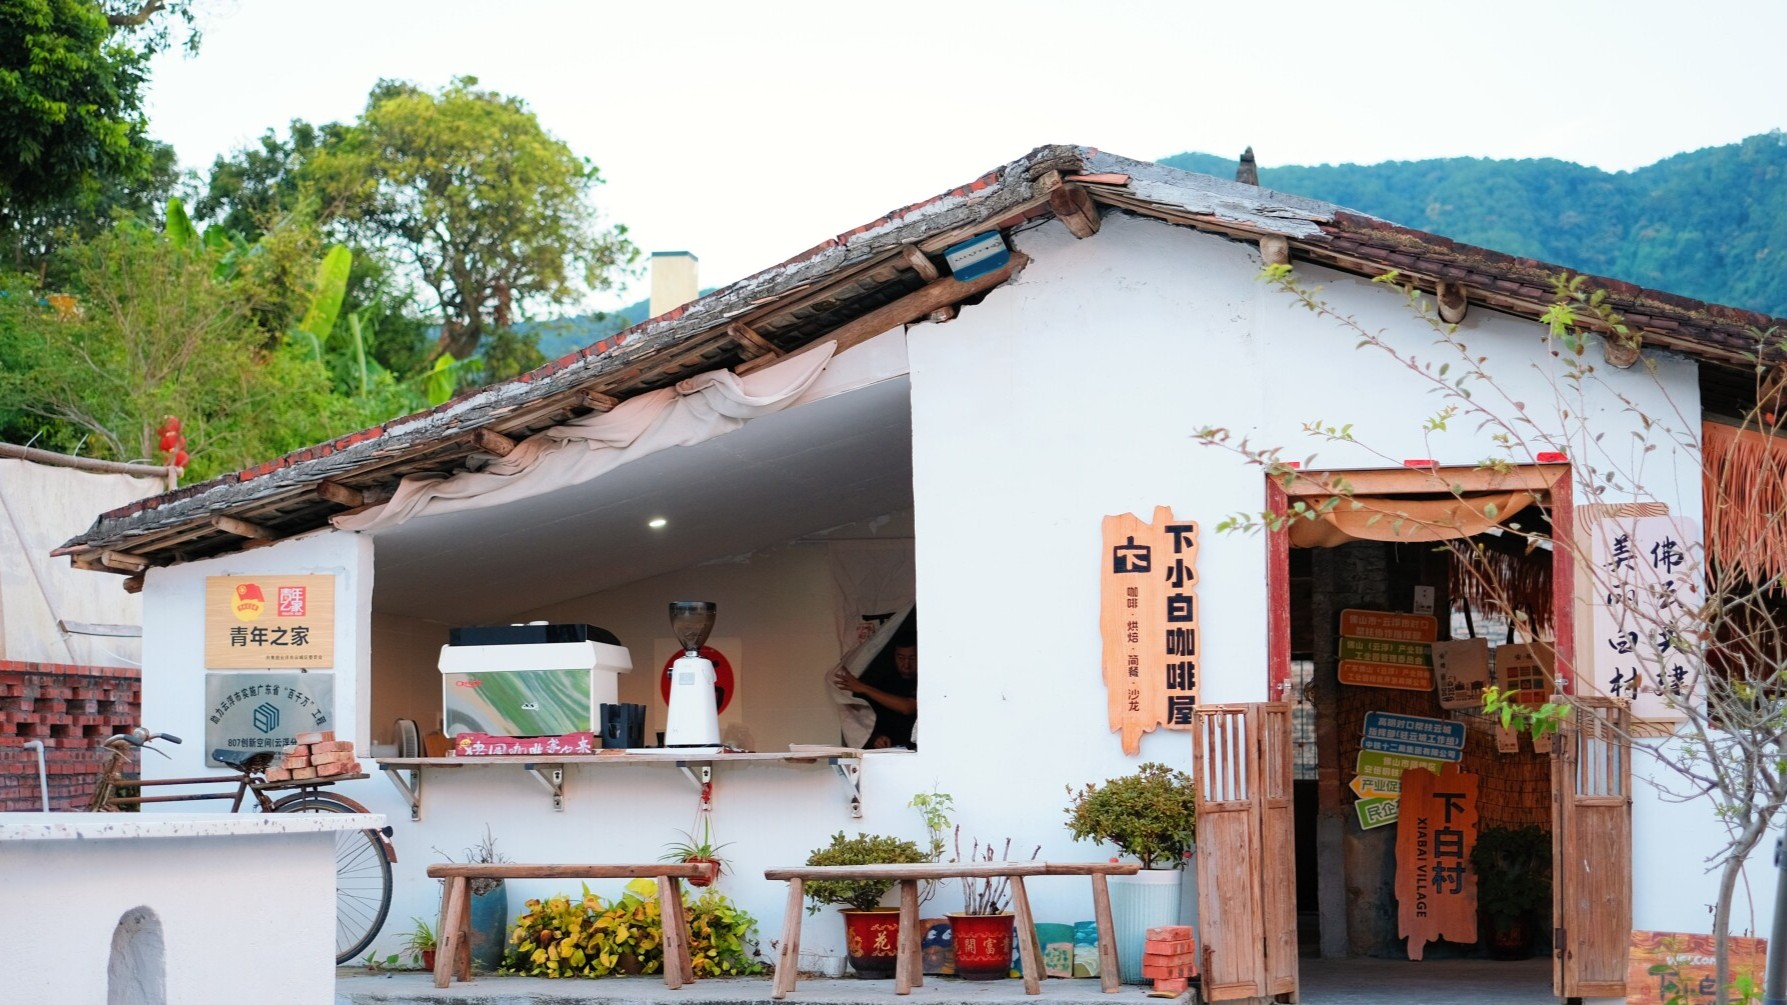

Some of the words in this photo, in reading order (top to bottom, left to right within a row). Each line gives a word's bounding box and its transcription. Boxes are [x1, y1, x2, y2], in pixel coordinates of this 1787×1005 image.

[230, 626, 310, 647] 青年之家
[1164, 524, 1196, 725] 下小白咖啡屋
[1361, 779, 1401, 793] 产业促
[1367, 801, 1400, 822] 民企
[1416, 817, 1428, 861] XIABAI
[1432, 793, 1466, 895] 下白村
[1416, 865, 1428, 918] VILLAGE
